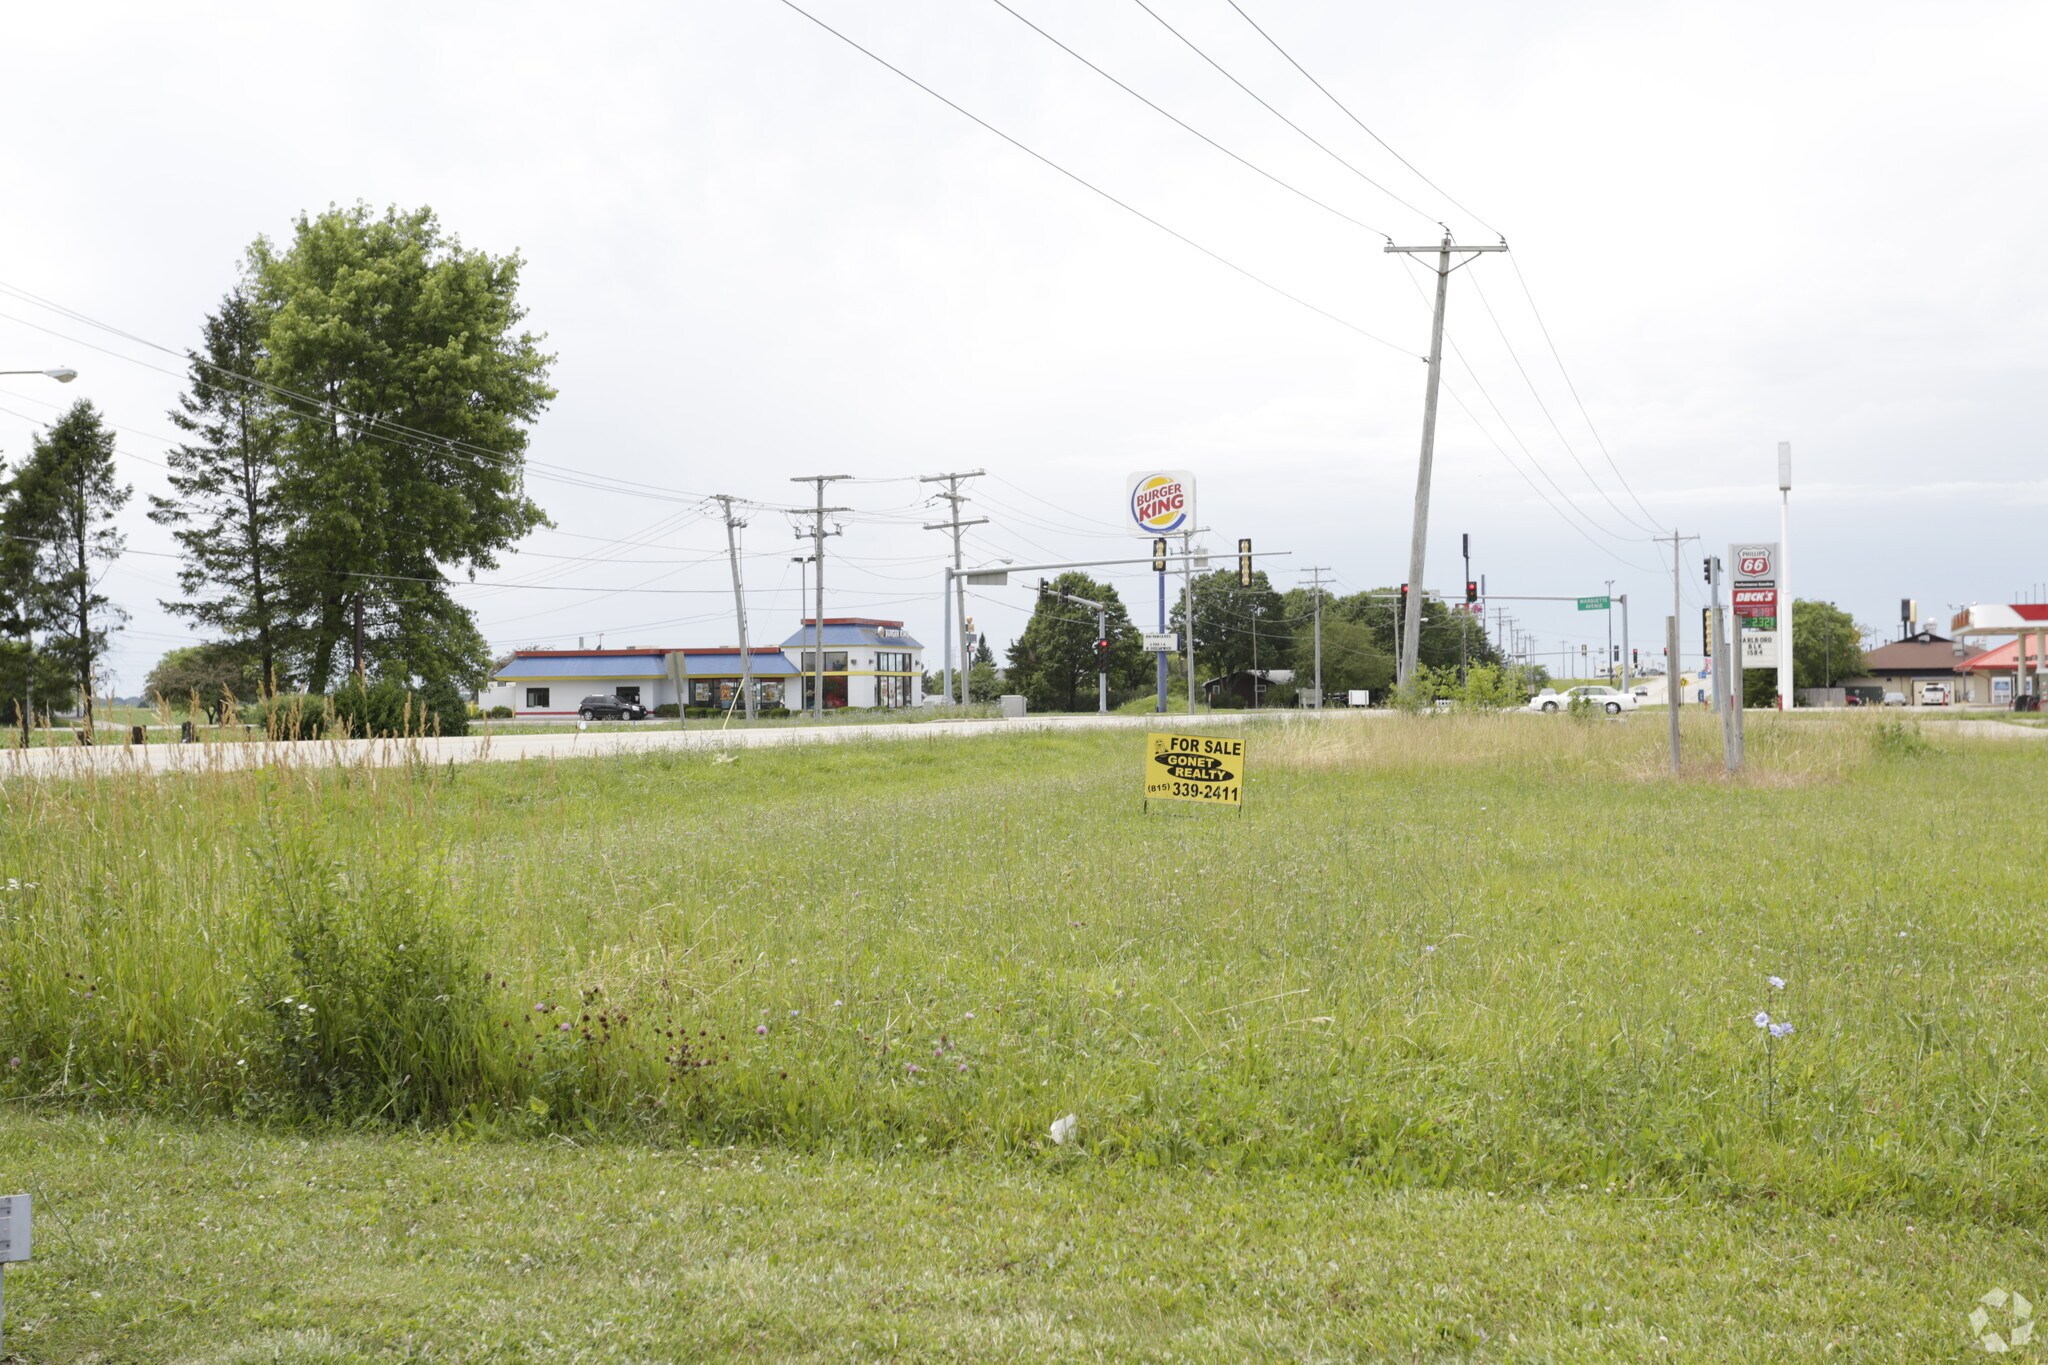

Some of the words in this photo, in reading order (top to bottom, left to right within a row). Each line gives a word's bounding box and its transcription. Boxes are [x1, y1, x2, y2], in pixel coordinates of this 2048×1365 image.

[1137, 483, 1181, 507] BURGER
[1139, 494, 1184, 522] KING
[1743, 559, 1764, 571] 66
[1736, 590, 1774, 602] DECK'S
[1170, 738, 1199, 752] FOR
[1204, 740, 1241, 756] SALE
[1167, 755, 1214, 768] GONET
[1175, 767, 1226, 780] REALTY
[1148, 783, 1171, 793] (815)
[1173, 782, 1238, 801] 339-2411
